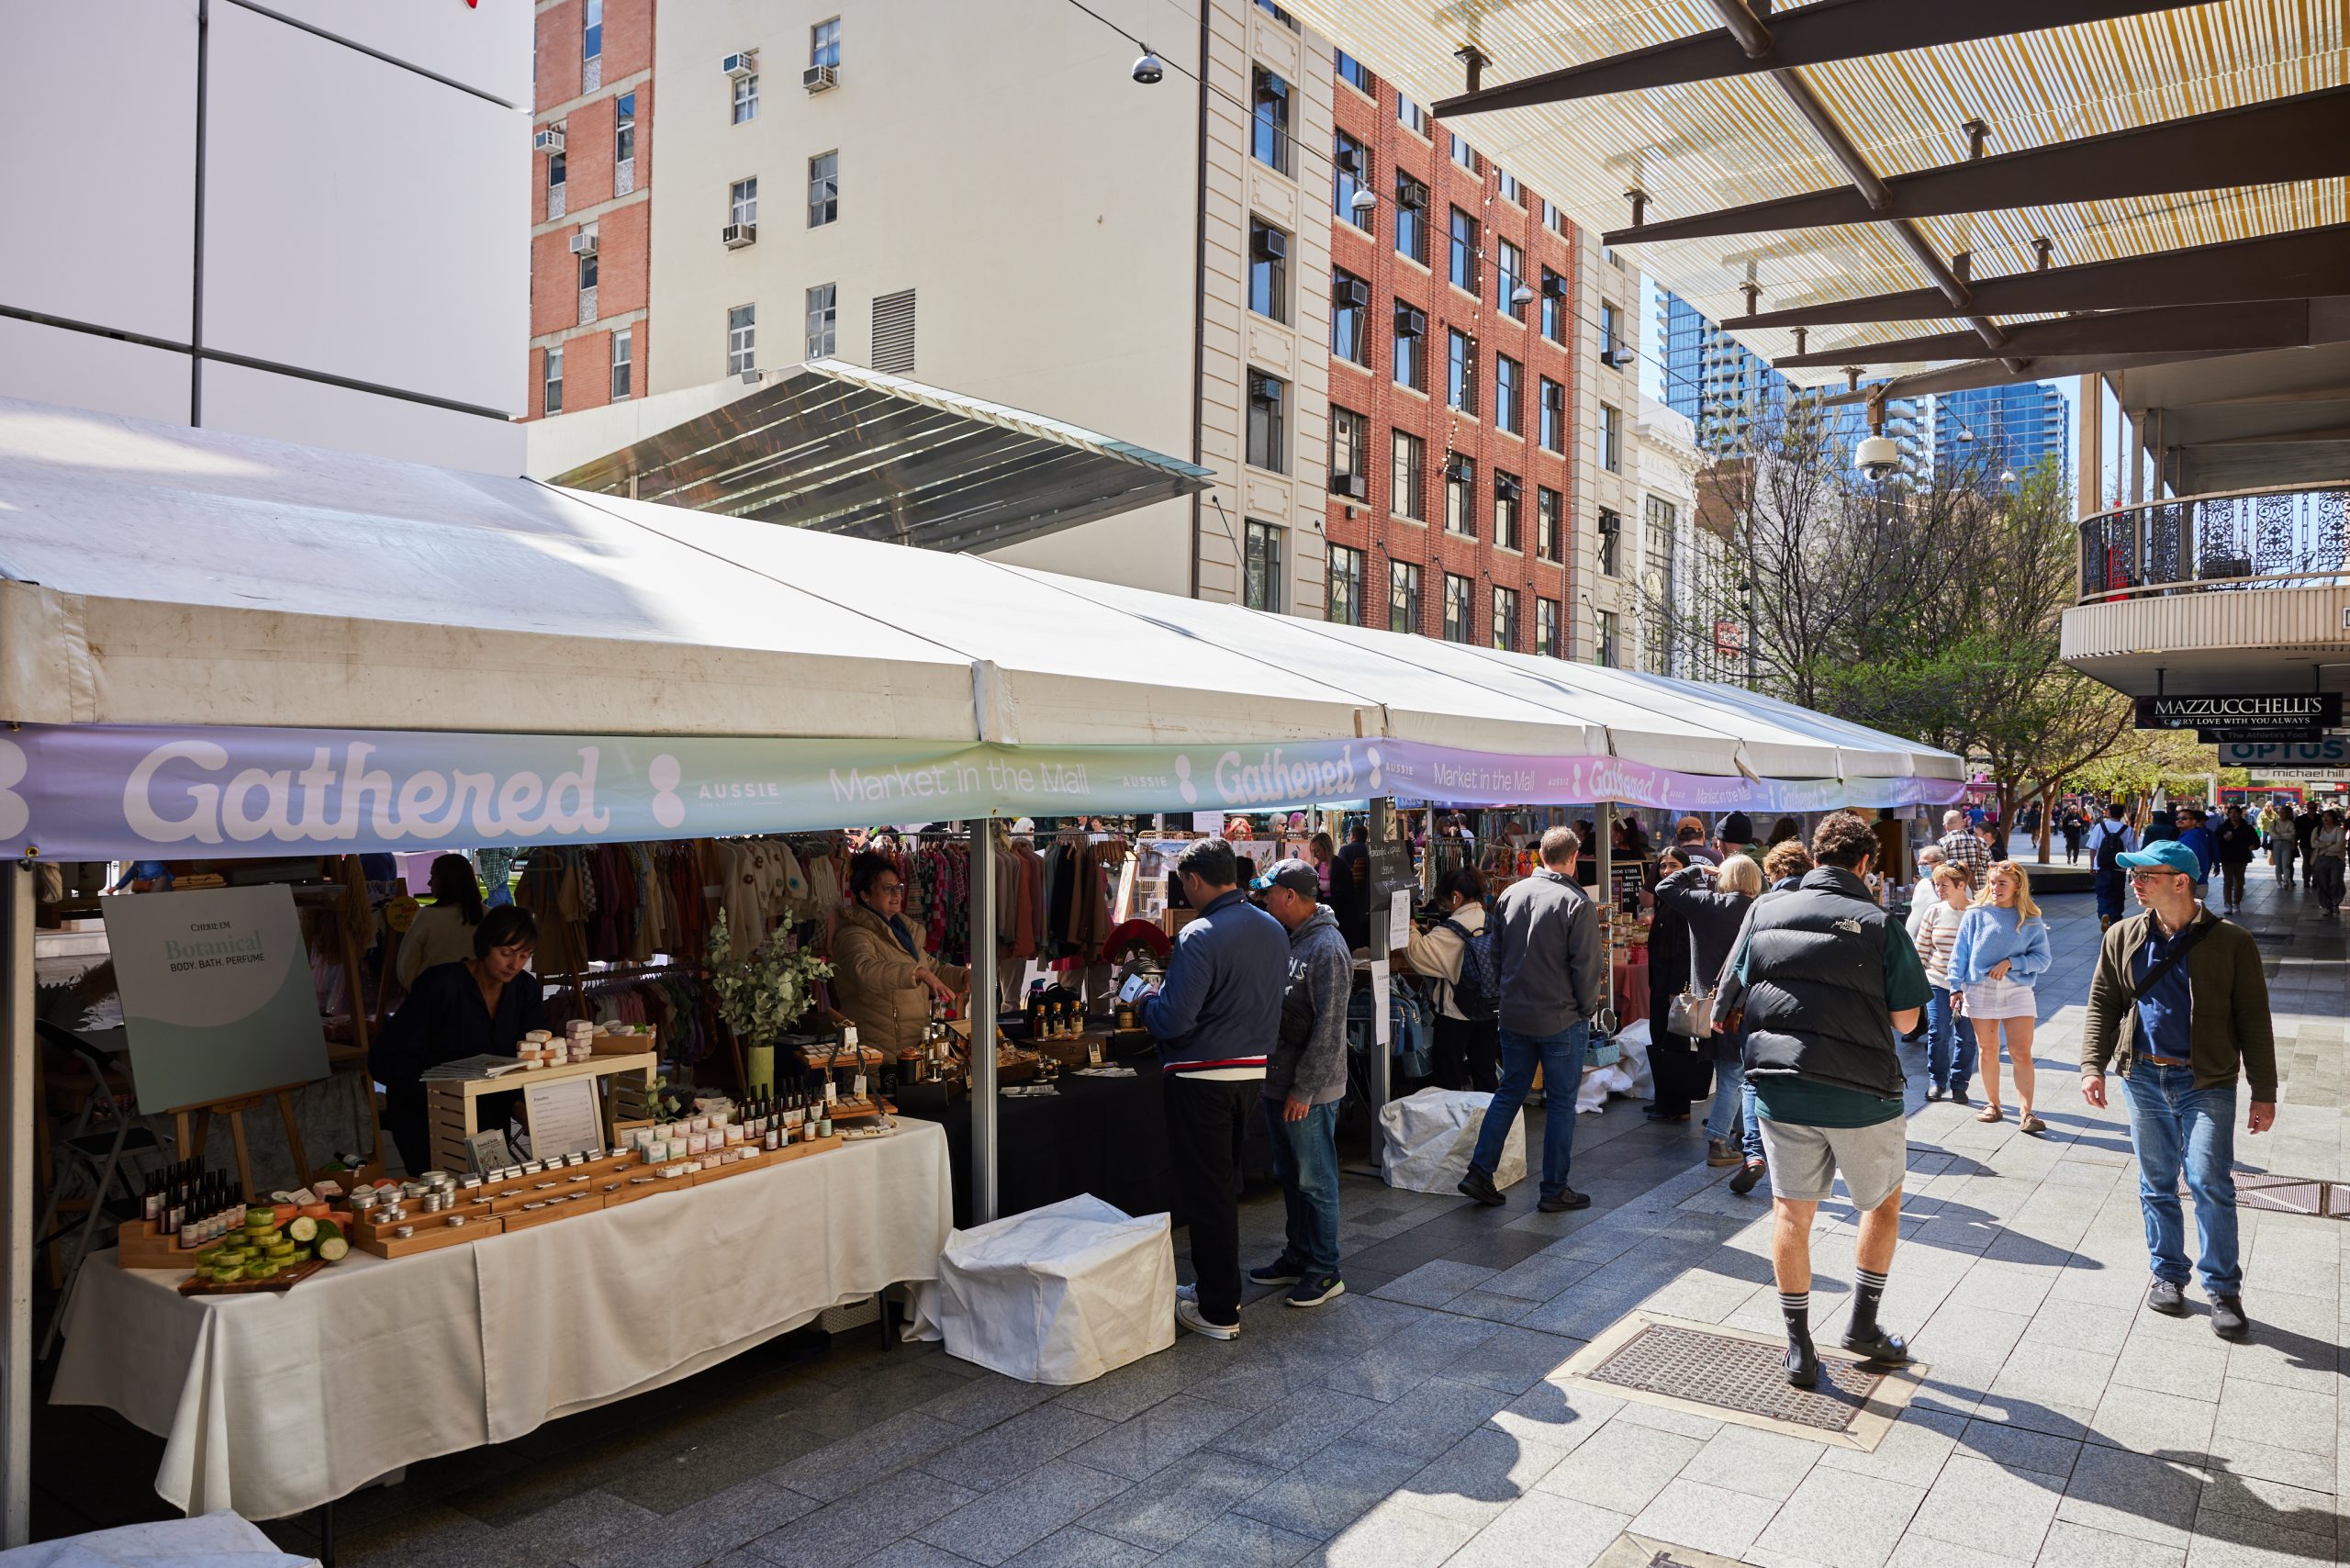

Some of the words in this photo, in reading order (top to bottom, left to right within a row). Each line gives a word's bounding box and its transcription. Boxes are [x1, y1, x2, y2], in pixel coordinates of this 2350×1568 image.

[2154, 697, 2322, 714] MAZZUCCHELLI'S
[2287, 731, 2309, 739] Foot
[2231, 739, 2344, 759] OPTUS
[1214, 745, 1358, 804] Gathered
[1385, 762, 1414, 776] AUSSIE
[1433, 763, 1477, 790] Market
[1480, 767, 1490, 790] in
[1492, 768, 1512, 791] the
[1513, 769, 1535, 792] Mall
[2272, 769, 2323, 778] michael
[2327, 769, 2344, 778] hill
[829, 764, 949, 802] Market
[952, 760, 981, 793] in
[987, 758, 1035, 792] the
[1040, 763, 1091, 794] Mall
[1123, 776, 1168, 788] AUSSIE
[1548, 778, 1569, 787] AUSSIE
[1588, 760, 1657, 804] Gathered
[123, 739, 610, 845] Gathered
[699, 782, 779, 799] AUSSIE
[164, 930, 263, 960] Botanical
[226, 953, 265, 966] PERFUME
